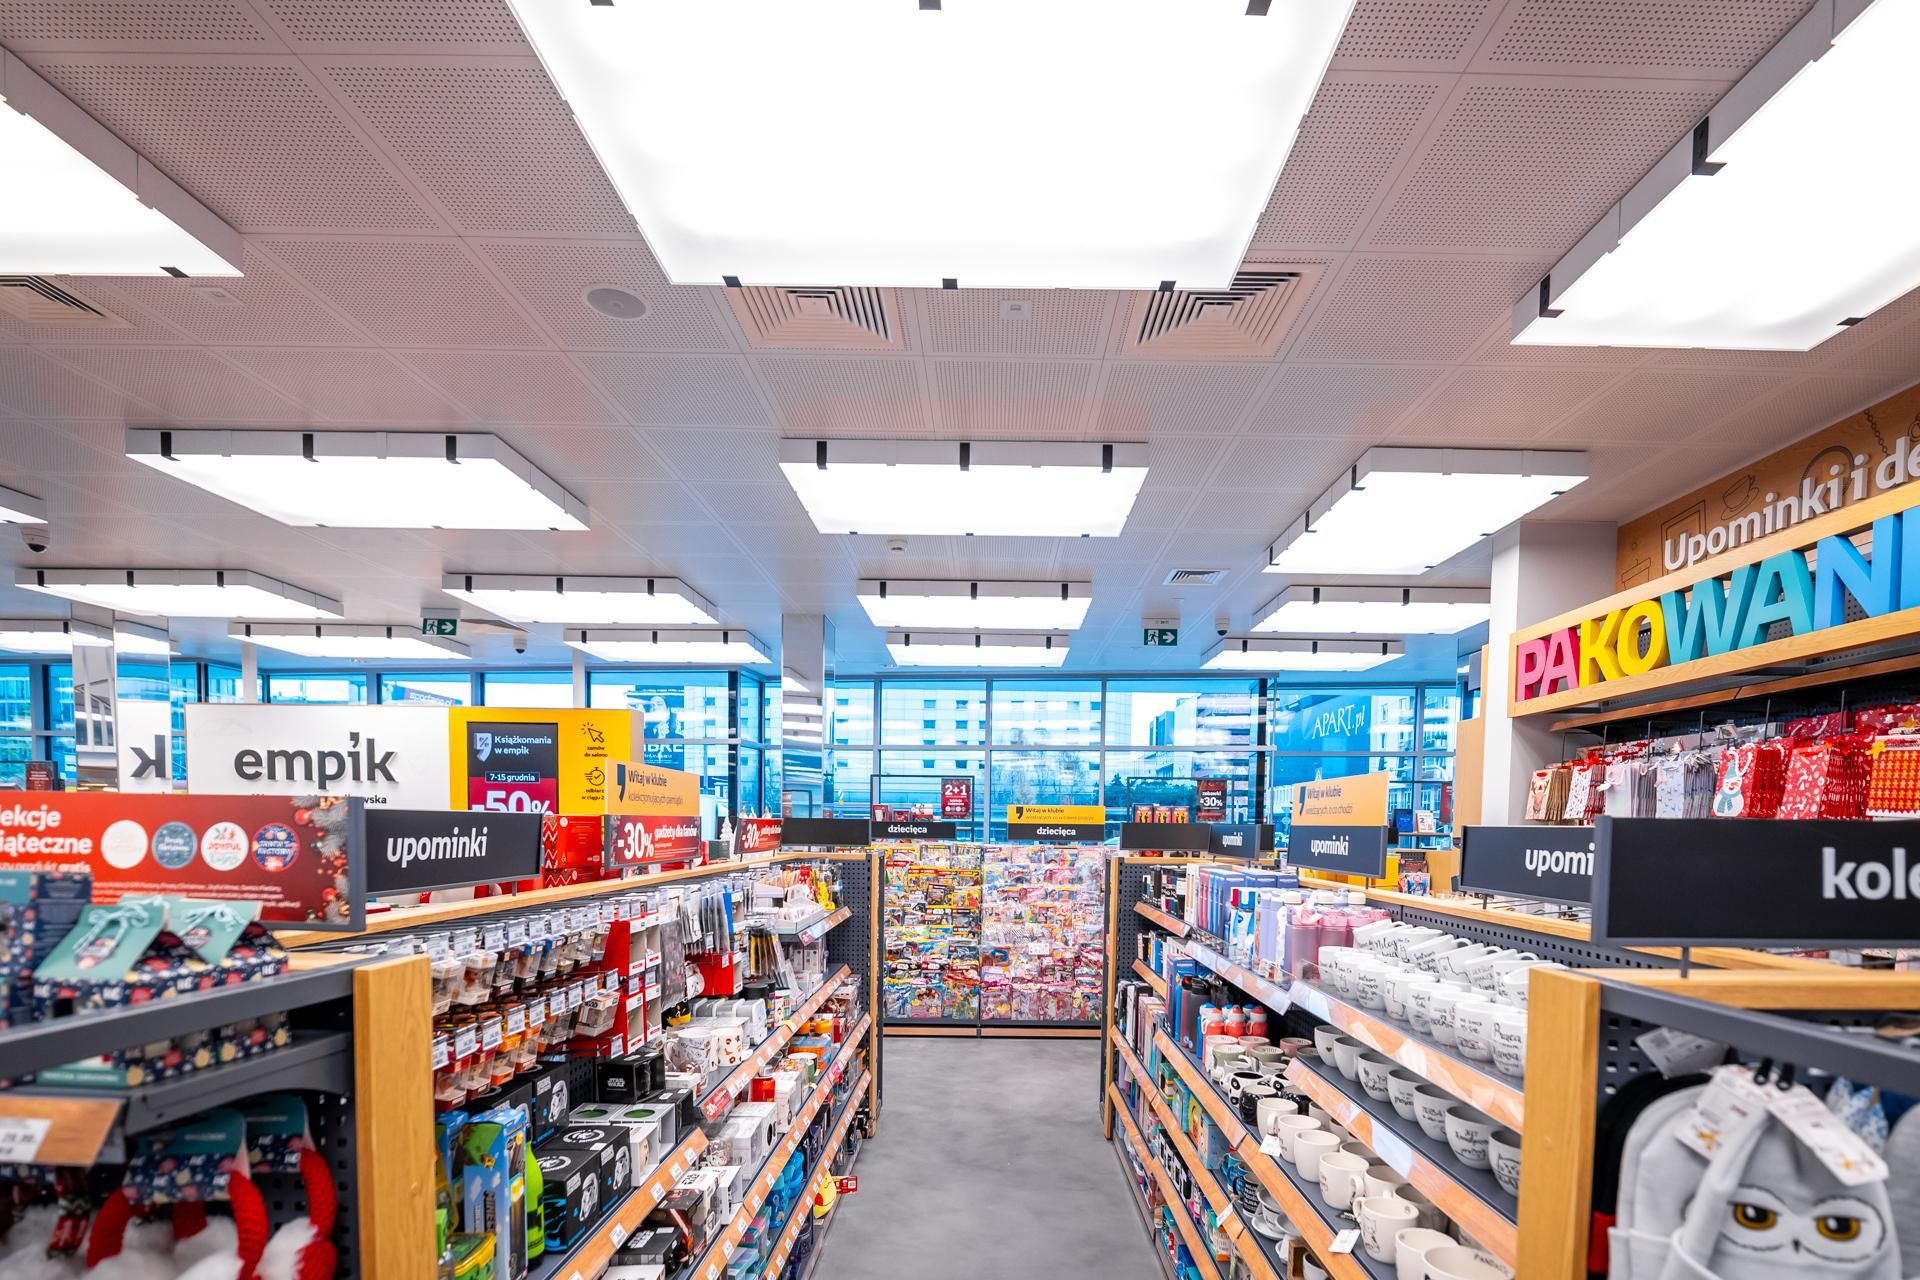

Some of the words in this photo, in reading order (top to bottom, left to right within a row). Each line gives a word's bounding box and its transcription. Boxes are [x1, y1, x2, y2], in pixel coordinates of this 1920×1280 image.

[1664, 464, 1844, 570] Upominki
[1851, 454, 1868, 500] i
[1312, 704, 1365, 739] APART.pl
[494, 736, 552, 745] Książkomania
[503, 745, 530, 756] empik
[234, 732, 397, 790] empik
[507, 774, 536, 783] grudnia
[628, 769, 645, 787] Witaj
[646, 776, 650, 784] w
[651, 773, 668, 787] klubie
[945, 784, 967, 796] 2+1
[741, 823, 760, 849] -30%
[887, 825, 928, 834] dziecięca
[1036, 826, 1077, 837] dziecięca
[1222, 832, 1243, 847] upominki
[387, 827, 488, 867] upominki
[617, 822, 655, 860] -30%
[1310, 835, 1349, 857] upominki
[1525, 843, 1594, 877] upomi
